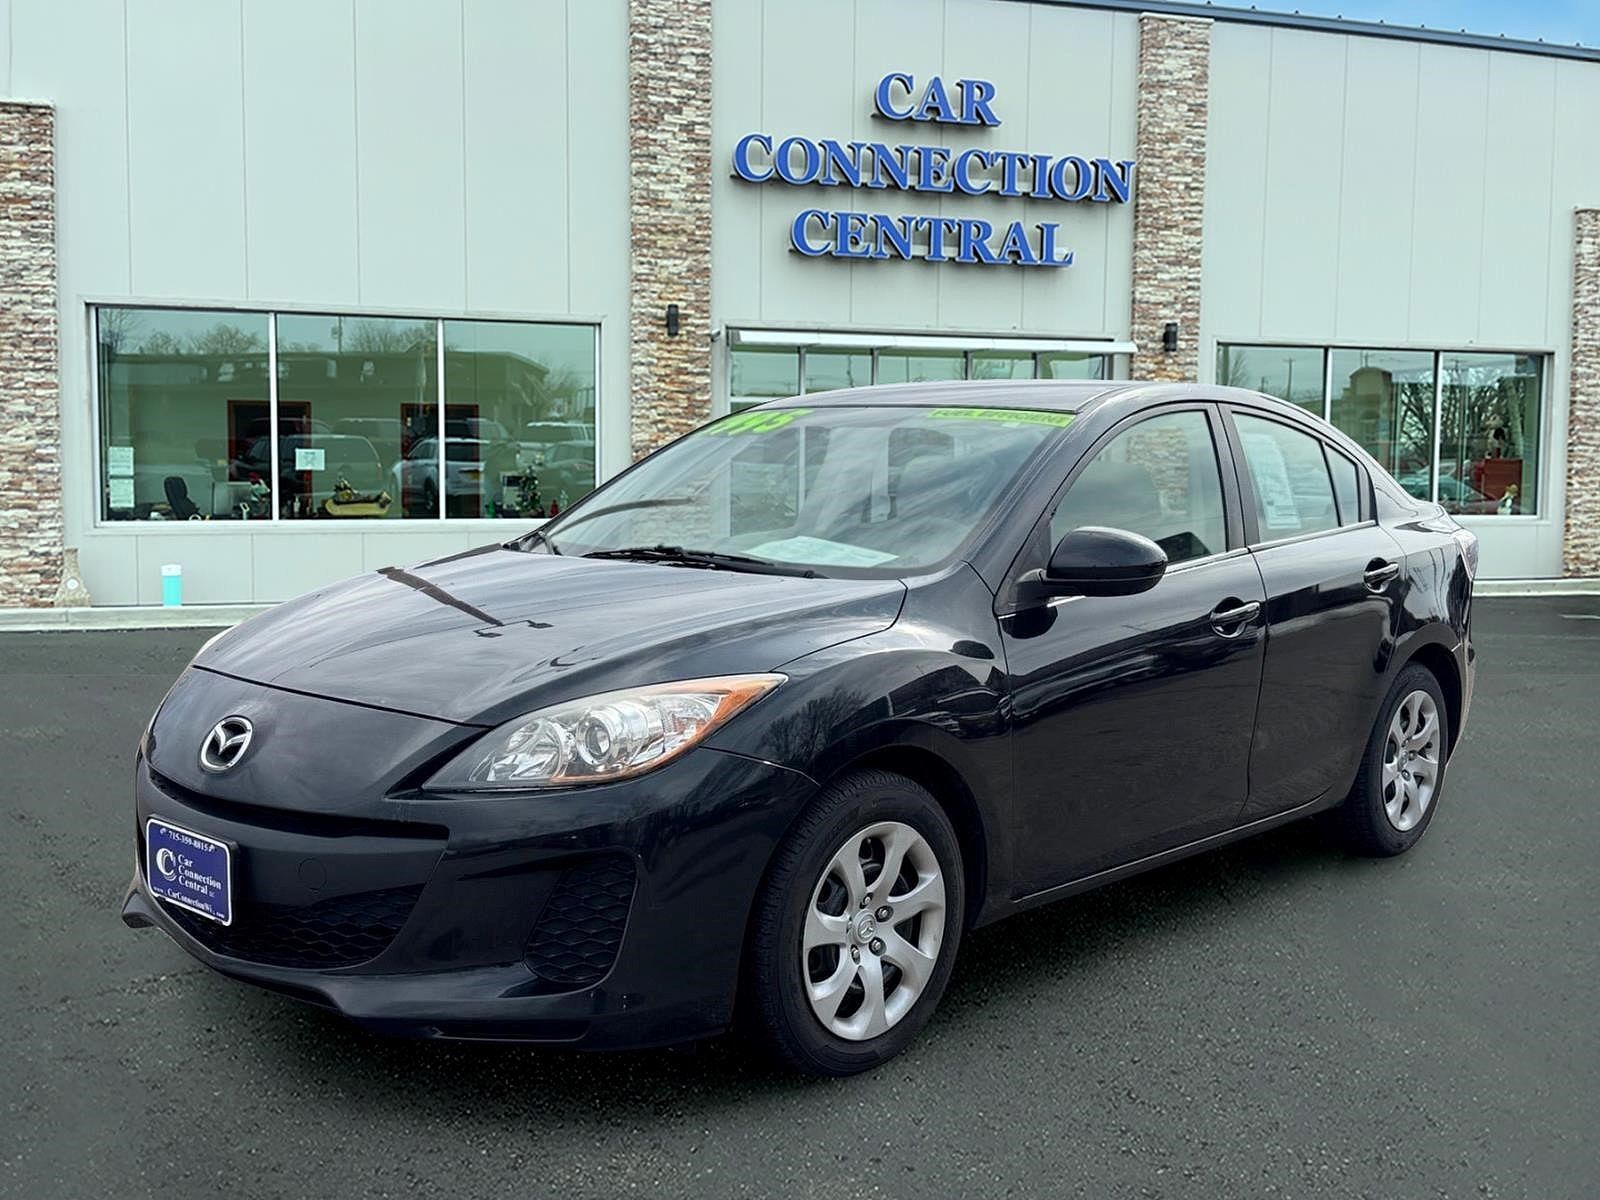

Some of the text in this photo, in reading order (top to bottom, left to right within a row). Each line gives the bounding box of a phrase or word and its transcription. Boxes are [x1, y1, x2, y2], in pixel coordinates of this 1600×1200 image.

[875, 72, 1002, 127] CAR
[732, 133, 1135, 204] CONNECTION
[790, 209, 1074, 267] CENTRAL
[178, 854, 193, 867] Car
[178, 865, 222, 890] Connection
[178, 875, 208, 895] Central
